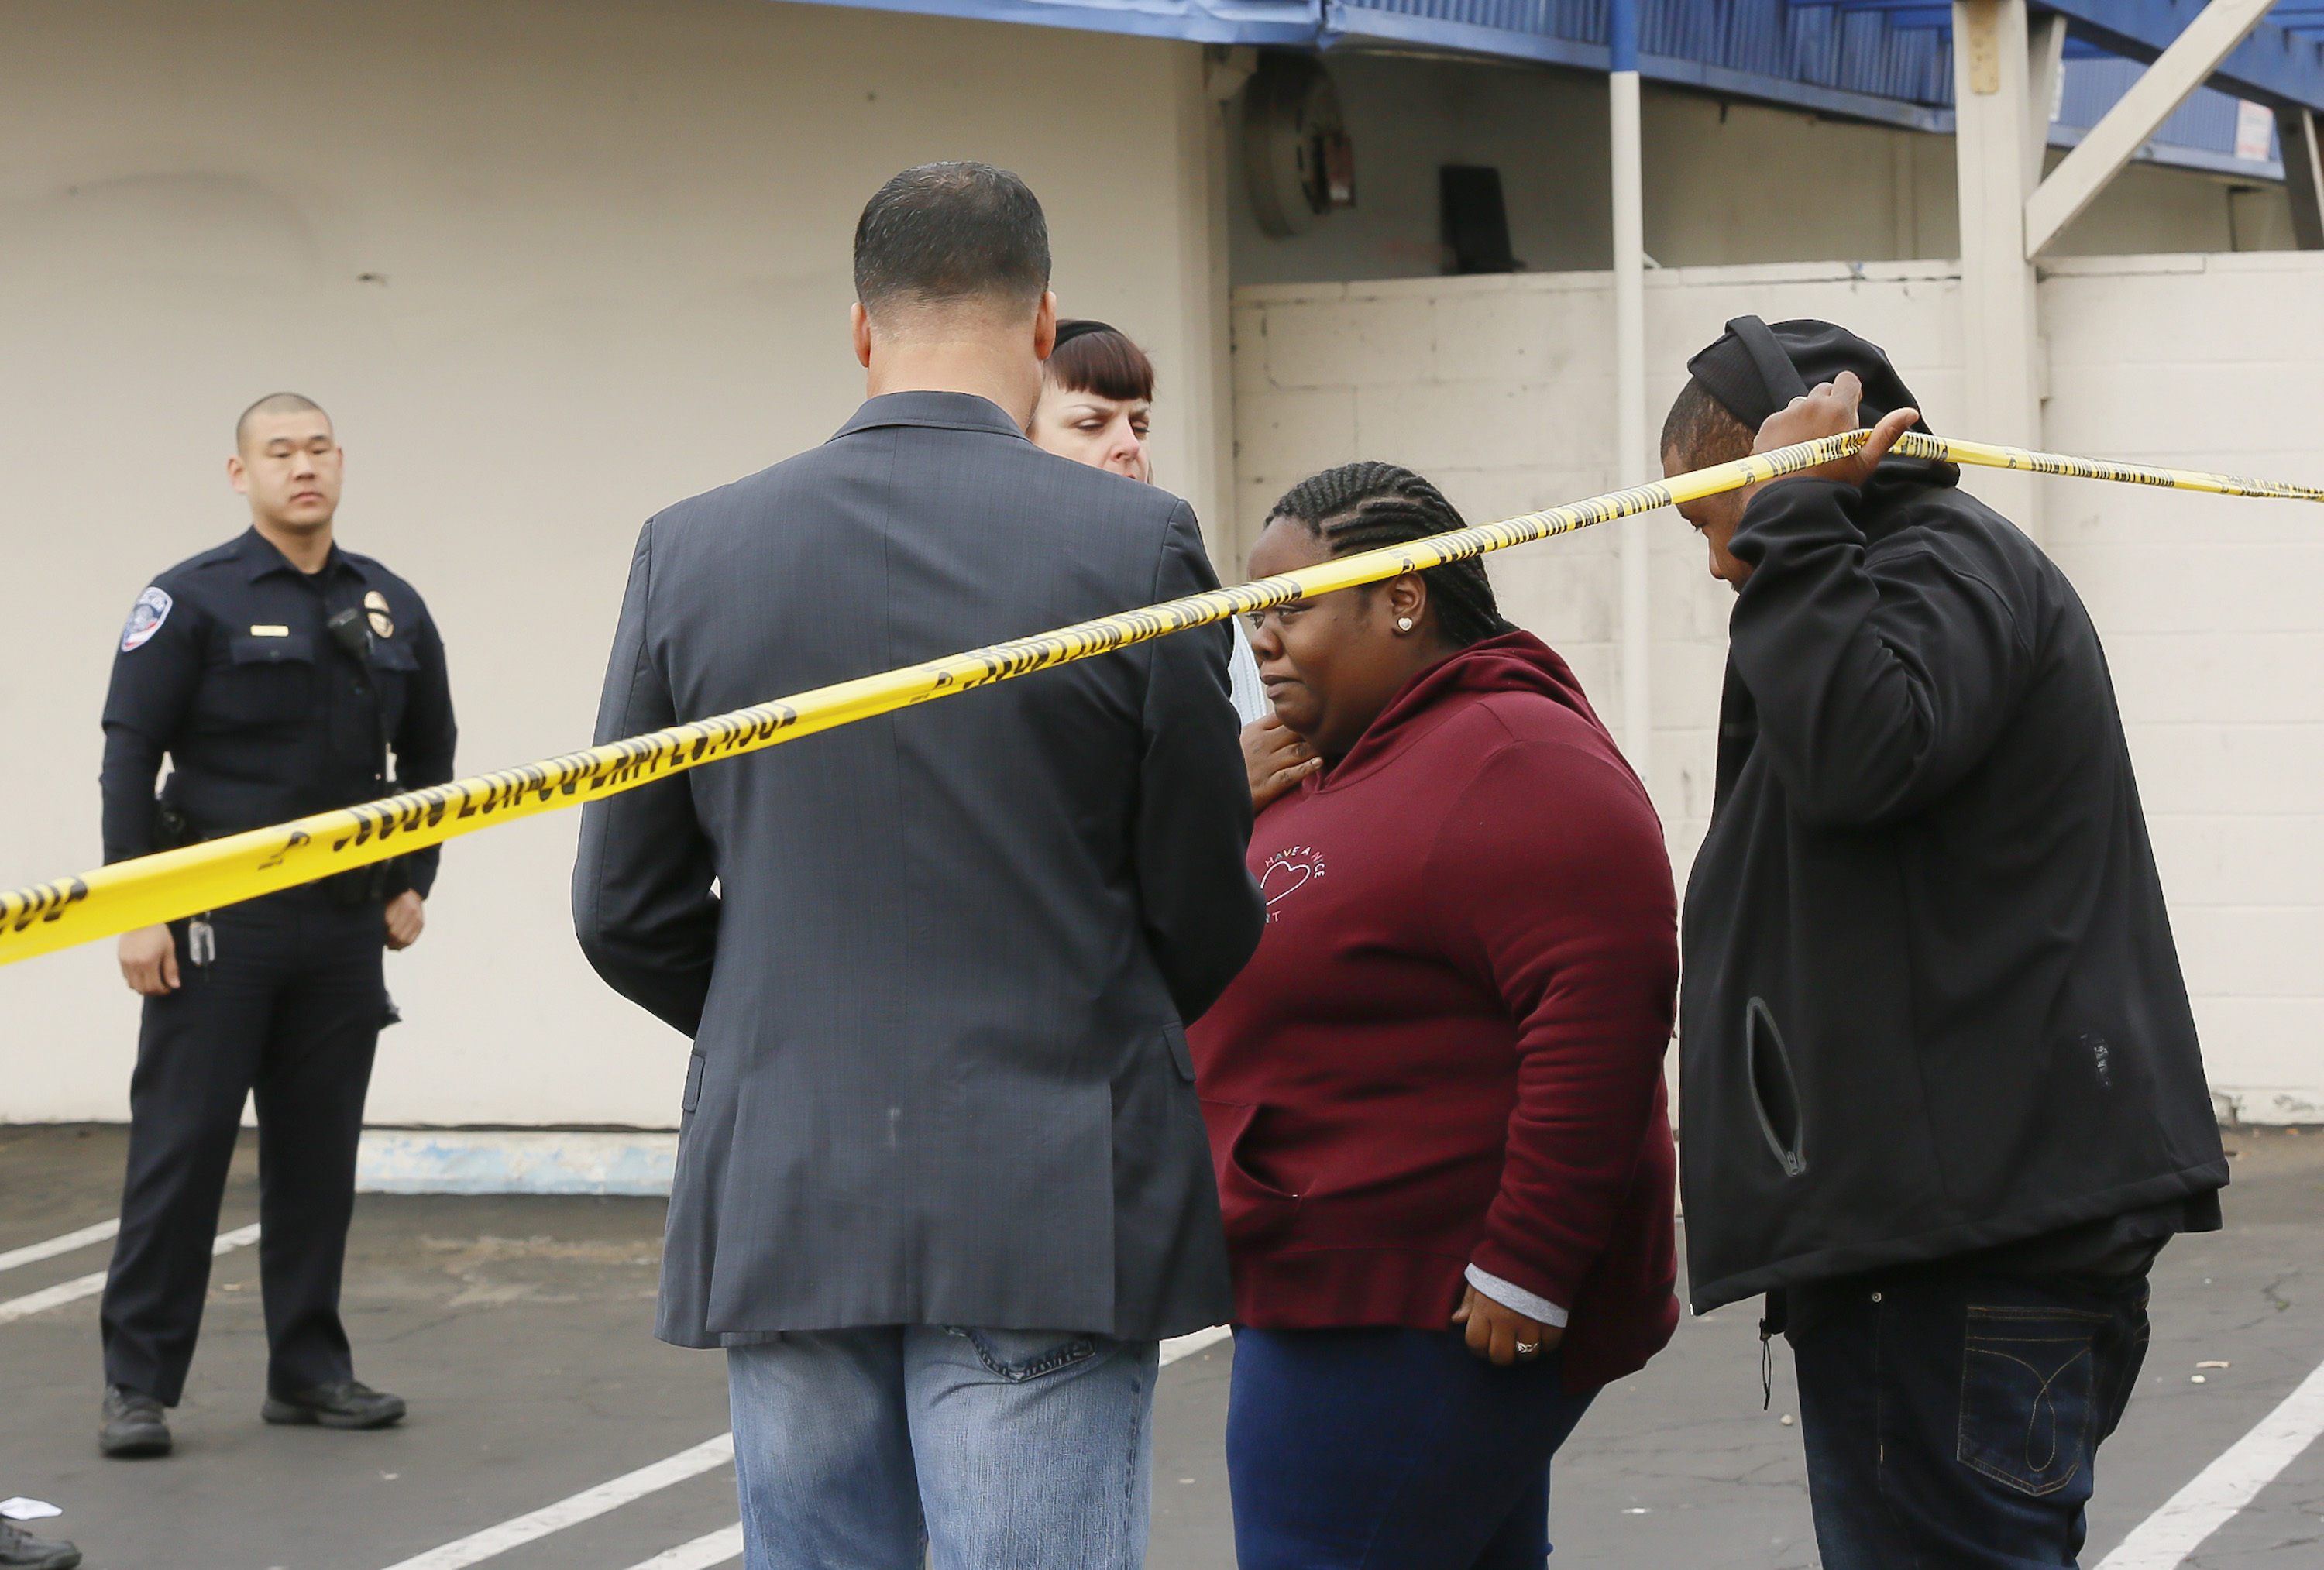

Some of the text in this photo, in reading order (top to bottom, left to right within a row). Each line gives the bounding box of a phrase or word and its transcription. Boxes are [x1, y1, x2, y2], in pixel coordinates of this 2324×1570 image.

[1265, 846, 1325, 878] HAVE A NICE
